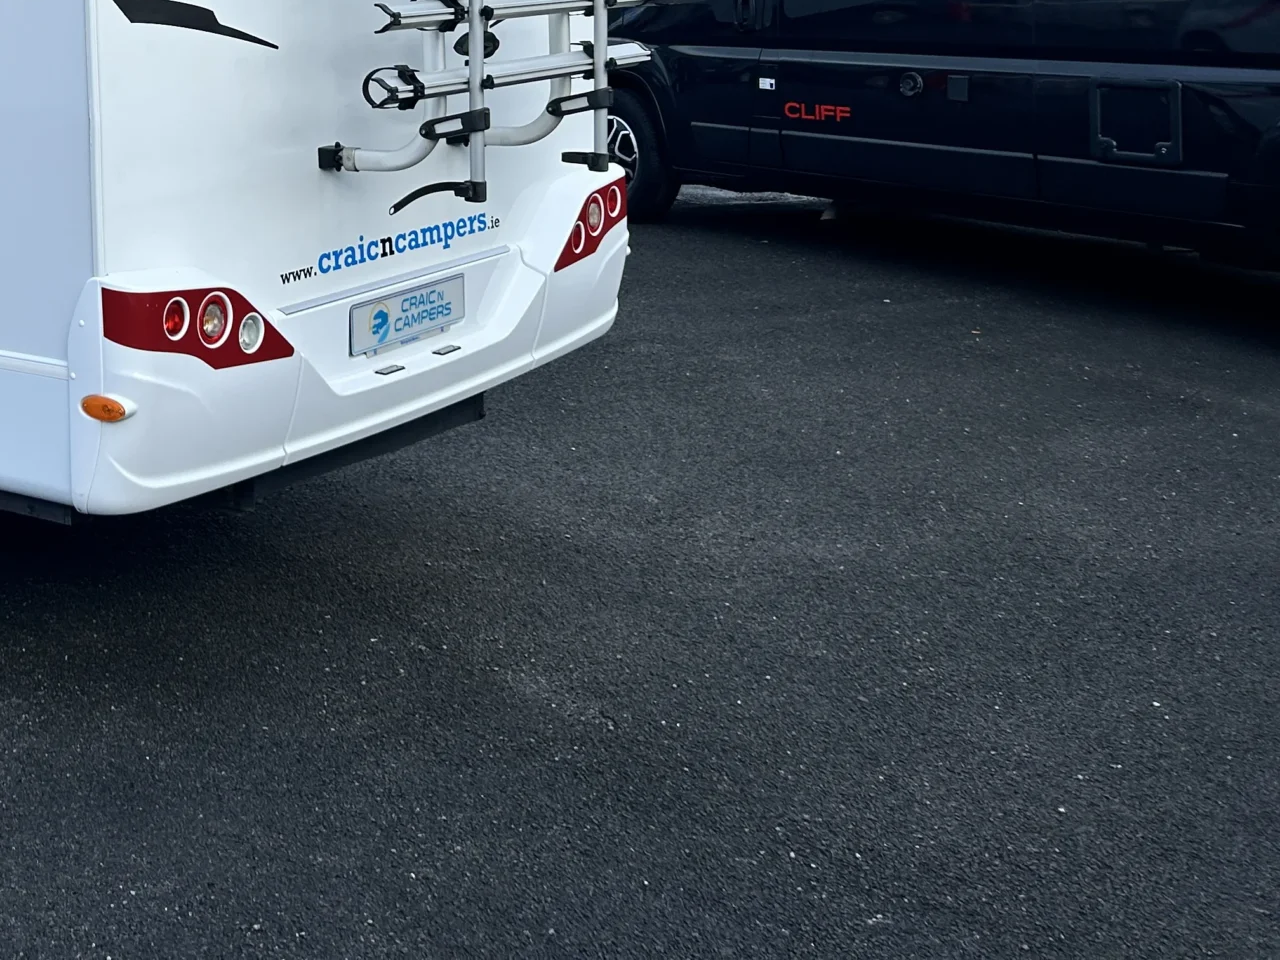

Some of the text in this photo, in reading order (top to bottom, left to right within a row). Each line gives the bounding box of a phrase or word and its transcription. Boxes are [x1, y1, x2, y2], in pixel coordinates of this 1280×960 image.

[784, 101, 851, 122] CLIFF
[280, 211, 501, 286] www.craicncampers.ie
[400, 289, 444, 313] CRAIC N
[394, 301, 452, 332] CAMPERS
